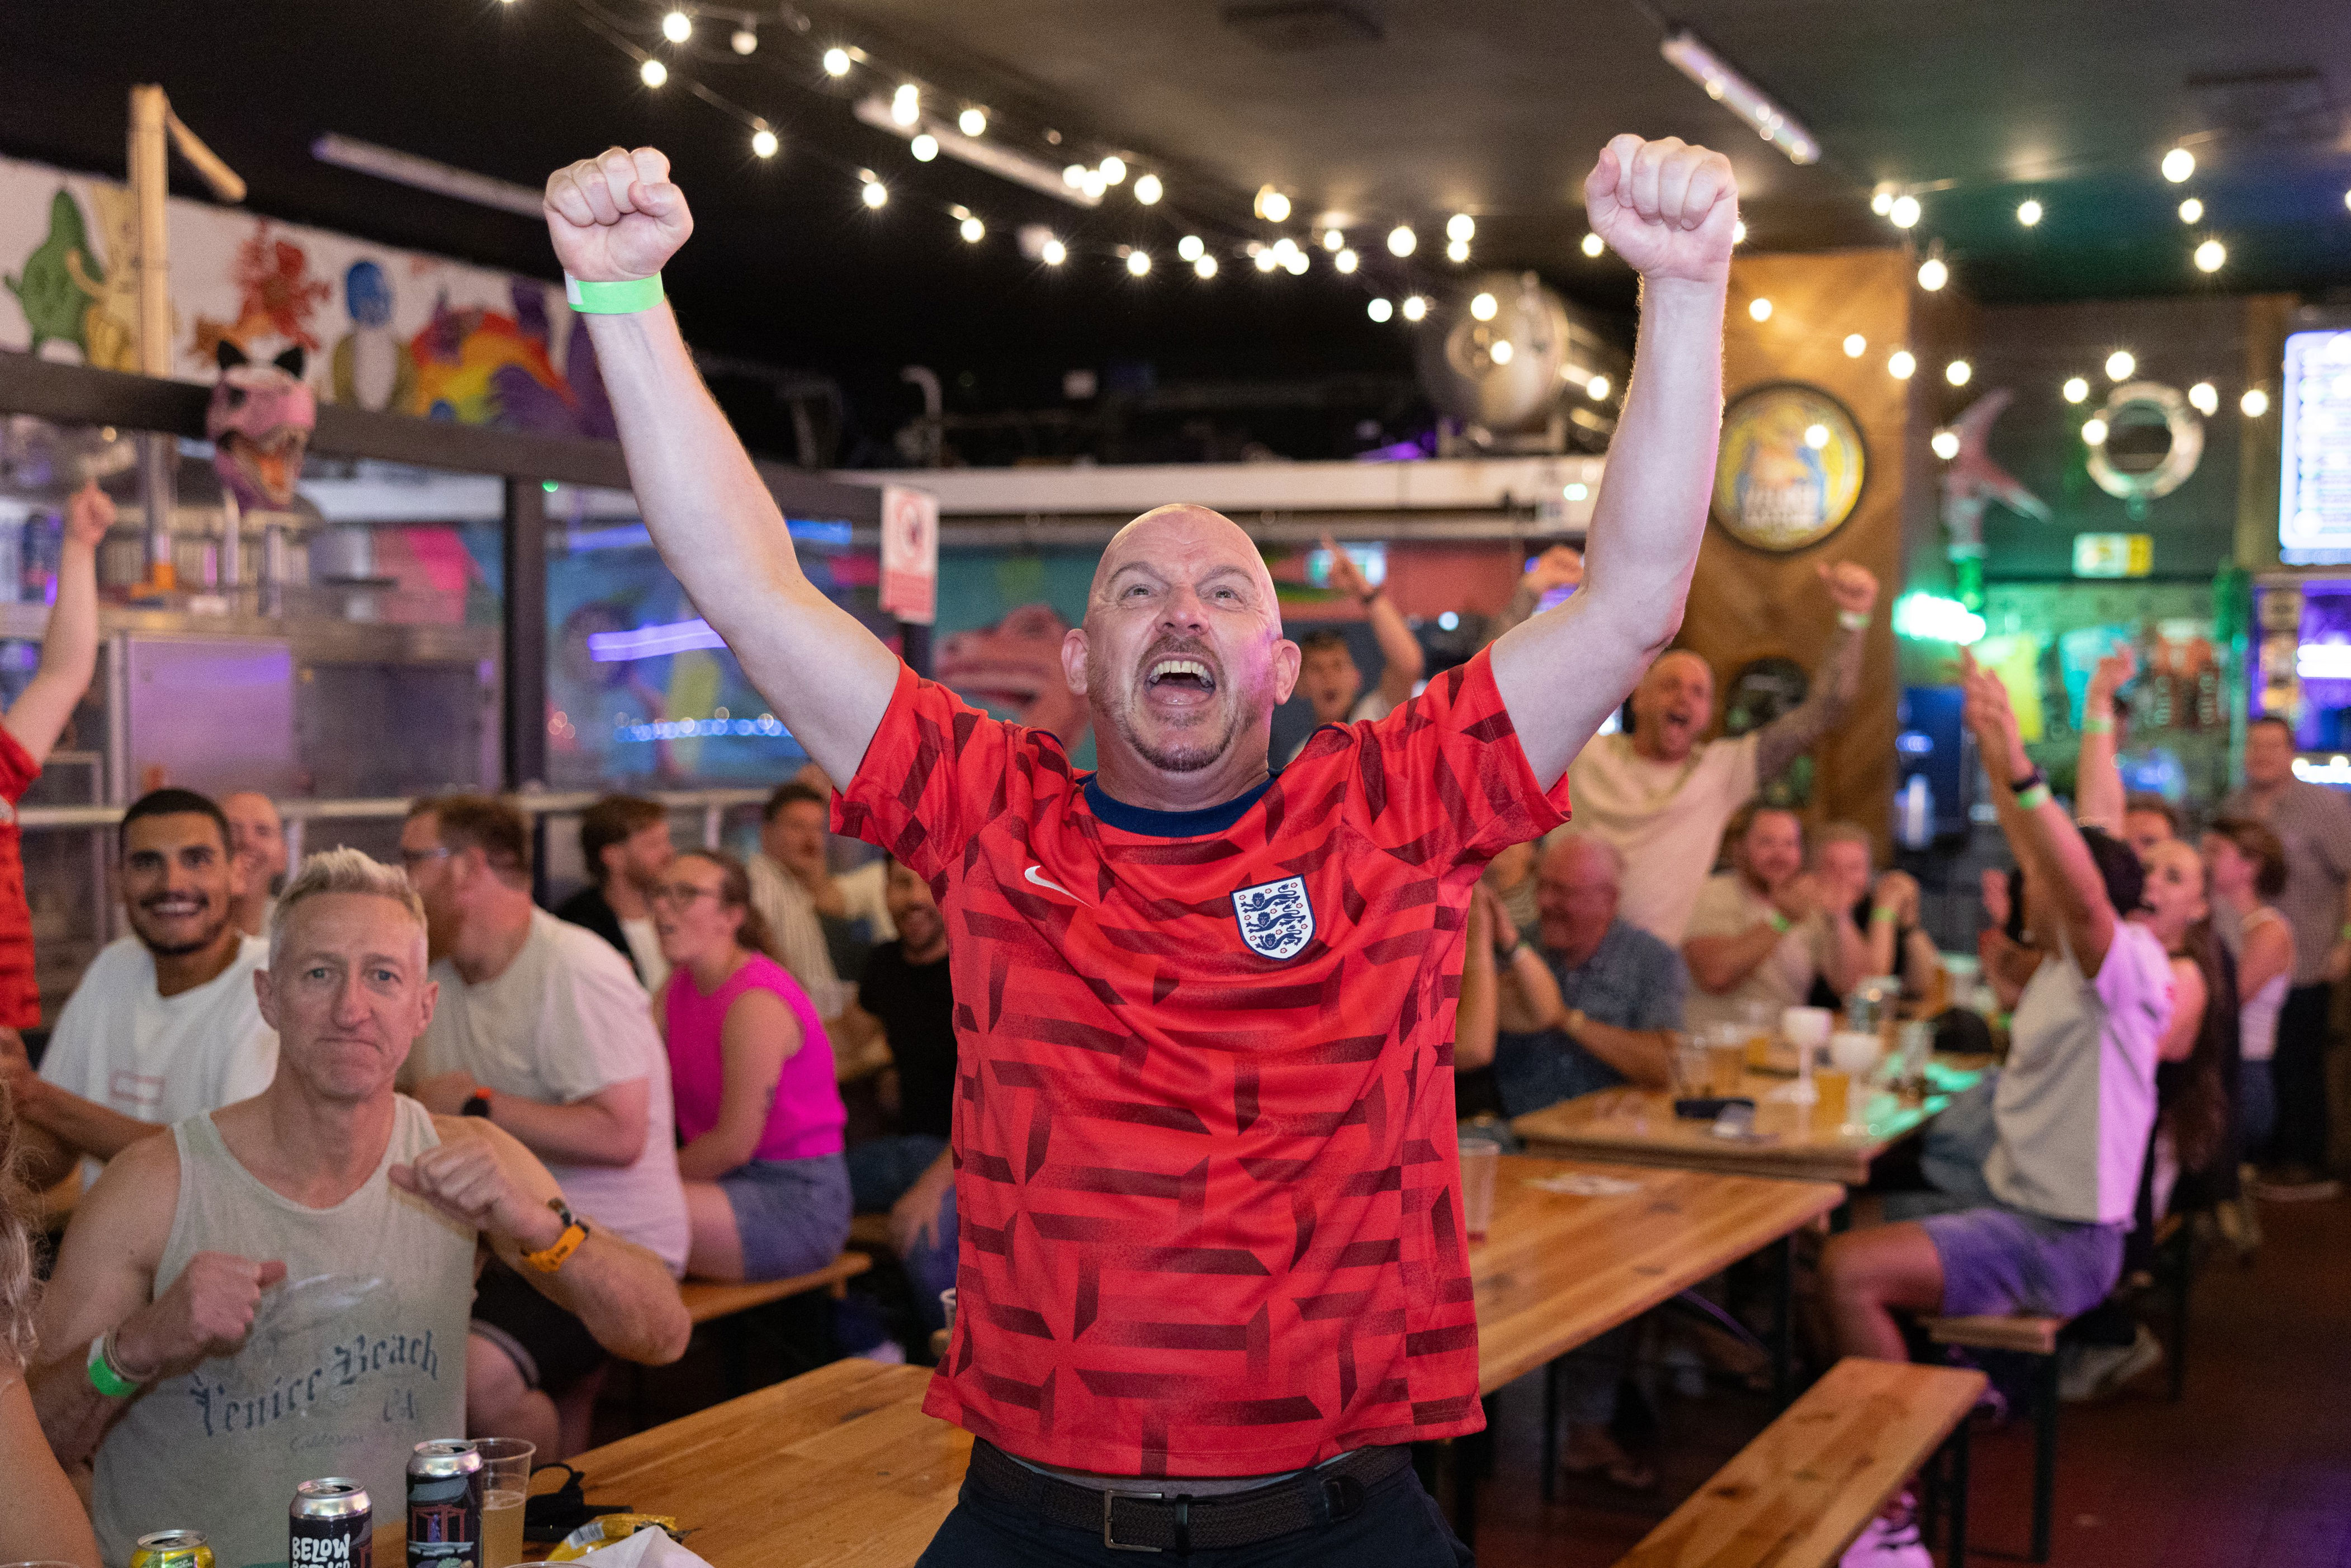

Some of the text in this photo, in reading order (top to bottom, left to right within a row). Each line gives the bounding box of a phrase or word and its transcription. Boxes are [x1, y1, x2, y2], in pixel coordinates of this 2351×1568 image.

[190, 1329, 438, 1436] Venice Beach
[292, 1533, 351, 1563] BELOW
